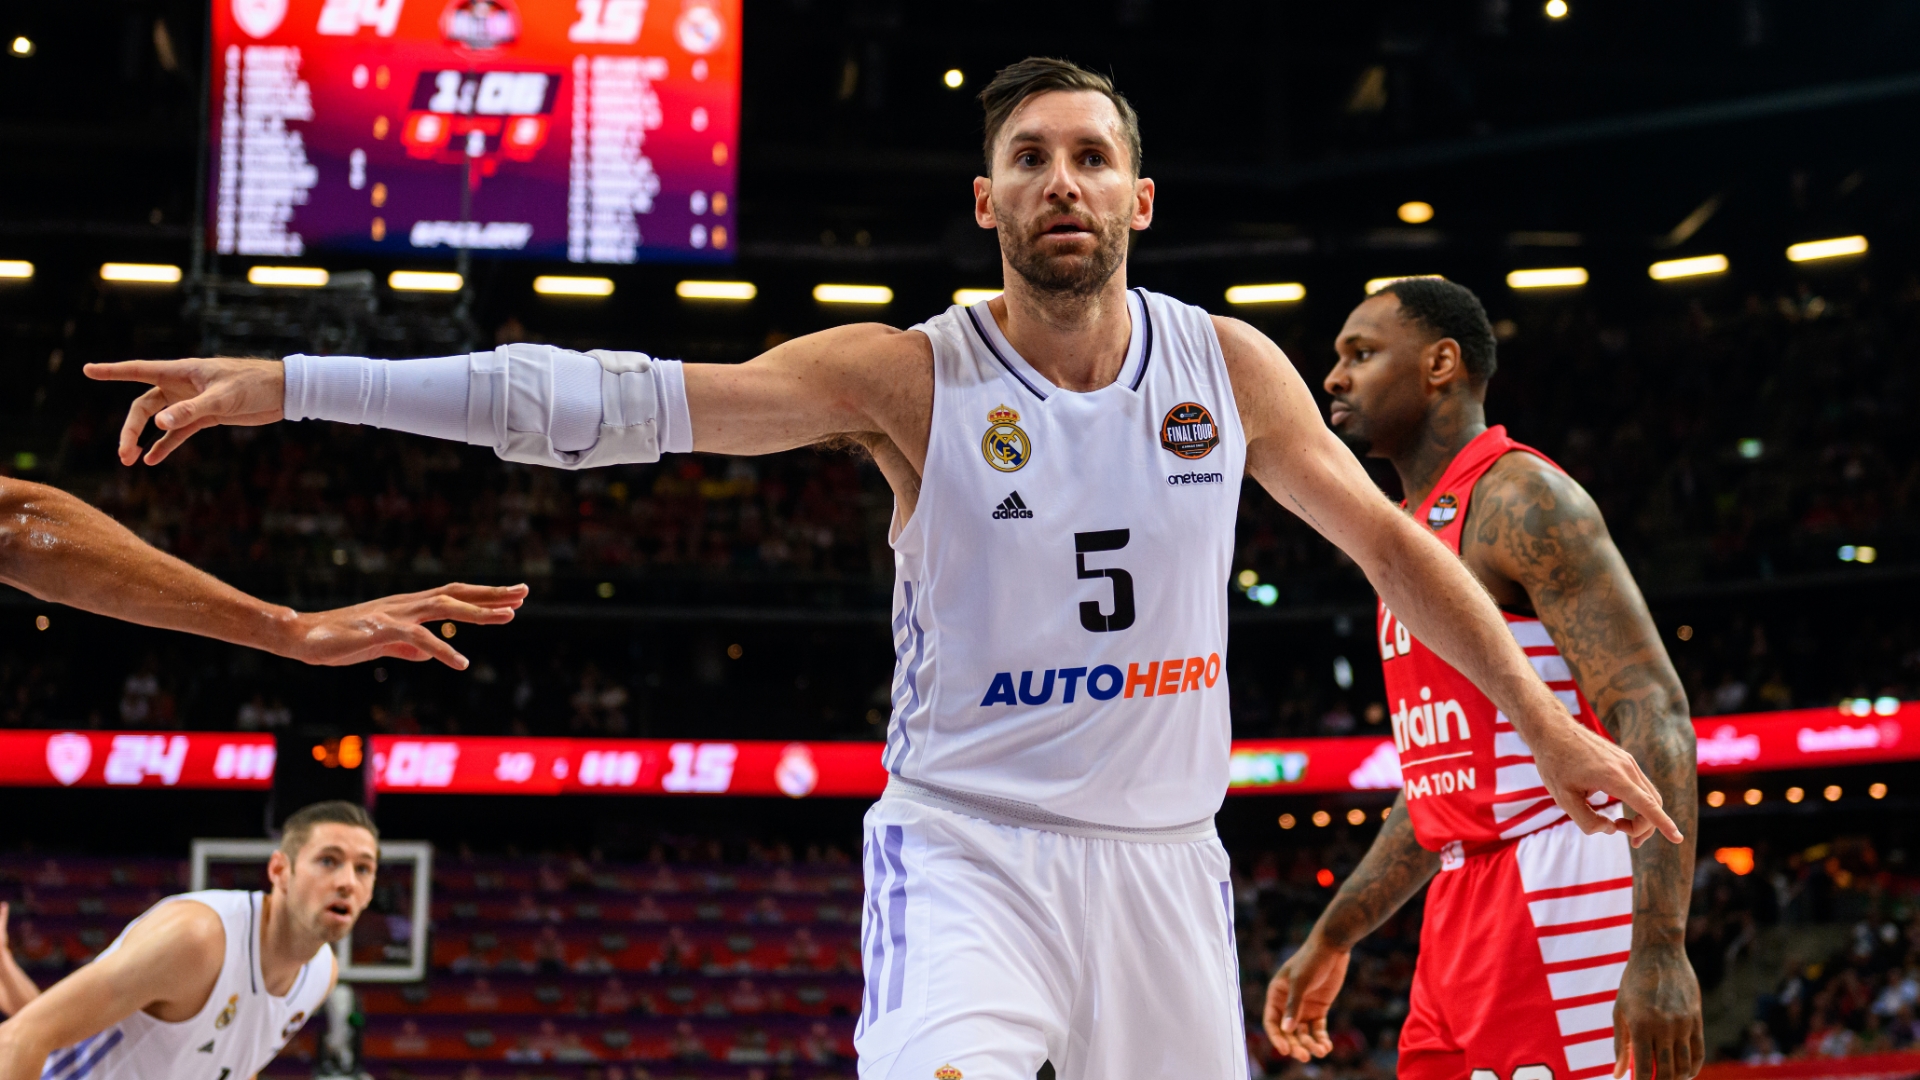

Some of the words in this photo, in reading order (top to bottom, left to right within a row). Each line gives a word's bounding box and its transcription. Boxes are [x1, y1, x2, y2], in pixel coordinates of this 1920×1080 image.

[1166, 425, 1193, 442] FINAL
[1192, 423, 1213, 441] FOUR
[1167, 471, 1223, 485] oneteam
[991, 509, 1034, 520] adidas
[1074, 528, 1136, 633] 5
[979, 652, 1221, 707] AUTOHERO
[103, 734, 190, 786] 24
[661, 742, 739, 793] 15
